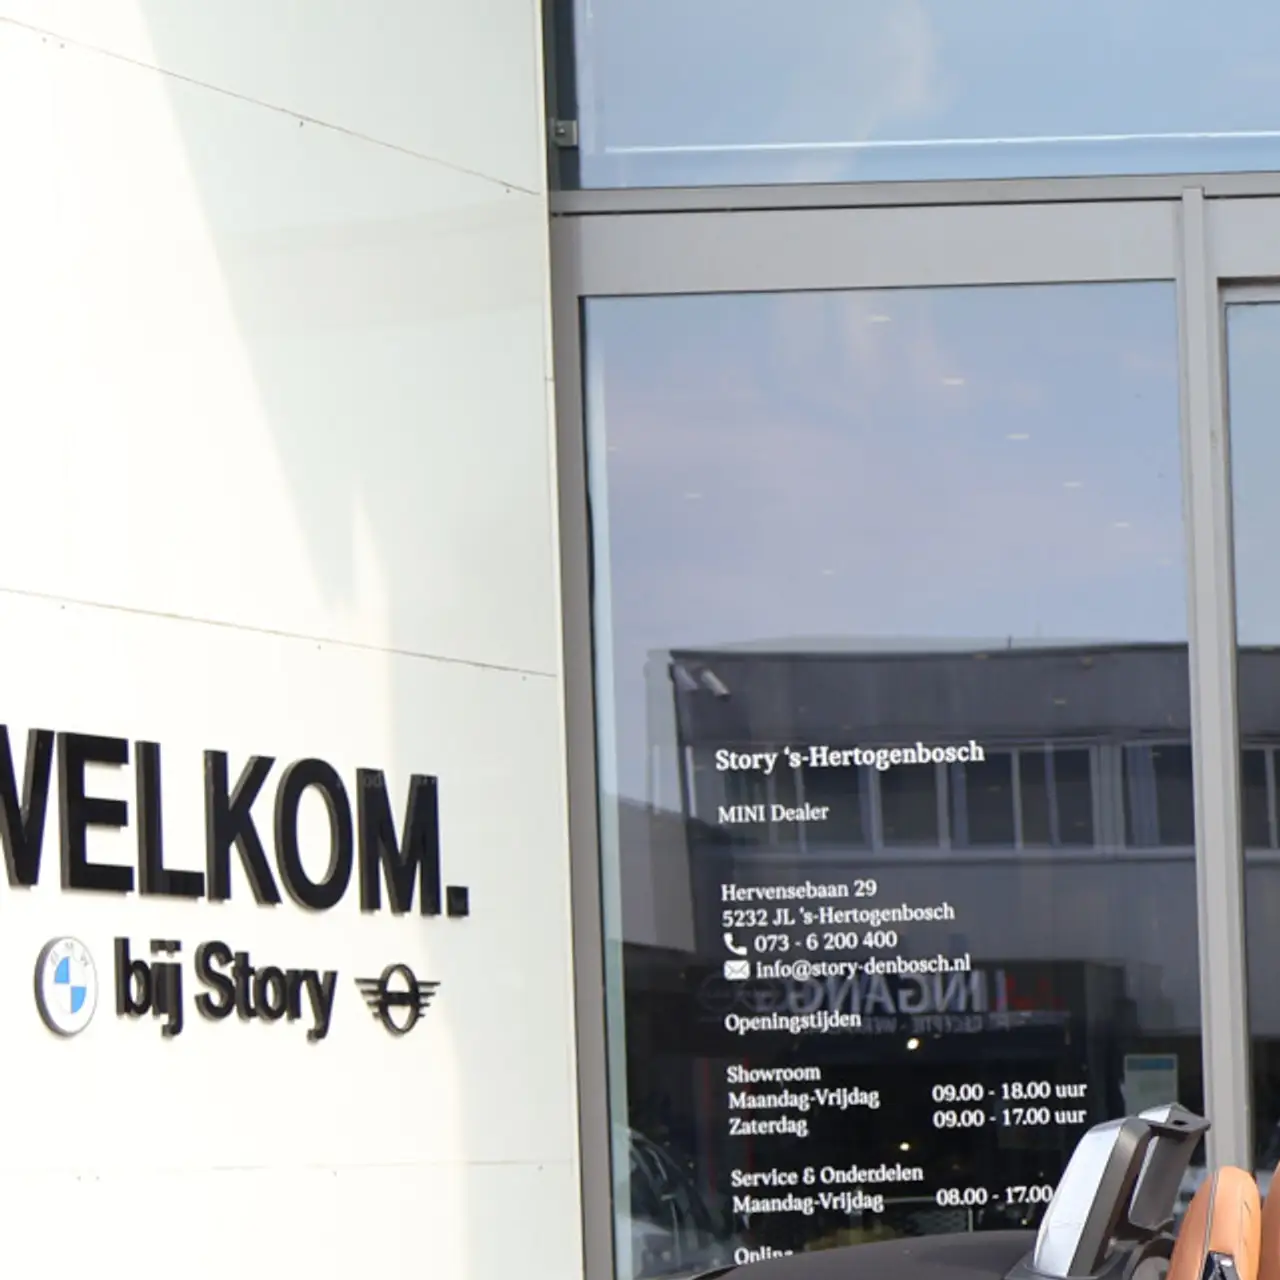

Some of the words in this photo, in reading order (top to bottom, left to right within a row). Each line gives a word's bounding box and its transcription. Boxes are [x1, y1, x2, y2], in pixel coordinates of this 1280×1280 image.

[716, 750, 777, 774] Story
[719, 805, 765, 823] MINI
[771, 803, 829, 821] Dealer
[722, 881, 848, 901] Hervensebaan
[854, 880, 877, 896] 29
[723, 909, 768, 927] 5232
[773, 909, 795, 925] JL
[755, 935, 789, 952] 073
[807, 933, 818, 950] 6
[824, 932, 858, 949] 200
[863, 931, 897, 947] 400
[757, 953, 970, 981] info@story-denbosch.nl
[114, 937, 183, 1038] bij
[195, 939, 338, 1042] Story
[725, 1009, 861, 1035] Openingstijden
[727, 1065, 820, 1083] Showroom
[729, 1087, 879, 1111] Maandag-Vrijdag
[932, 1084, 983, 1101] 09.00
[1003, 1082, 1051, 1099] 18.00
[1056, 1084, 1087, 1097] uur
[730, 1116, 808, 1137] Zaterdag
[934, 1110, 984, 1127] 09.00
[1003, 1108, 1050, 1125] 17.00
[1055, 1111, 1086, 1123] uur
[731, 1169, 798, 1187] Service
[803, 1167, 815, 1184] &
[820, 1164, 923, 1183] Onderdelen
[733, 1191, 883, 1215] Maandag-Vrijdag
[936, 1188, 987, 1205] 08.00
[1006, 1186, 1054, 1204] 17.00
